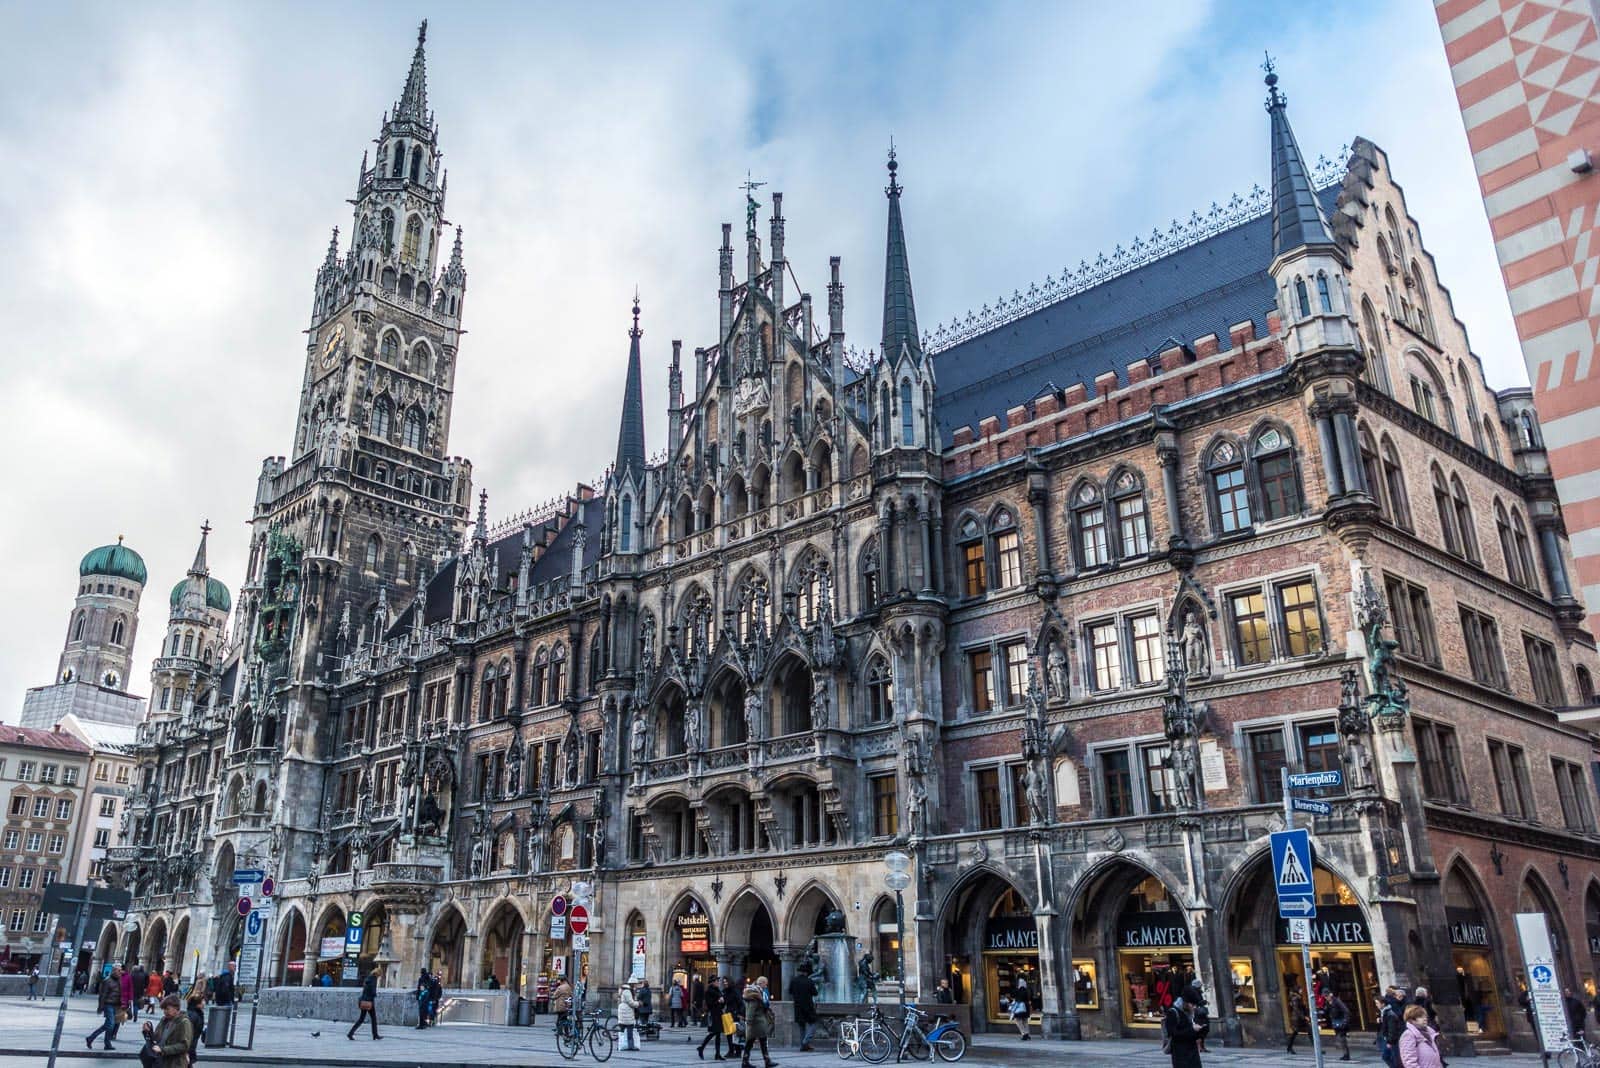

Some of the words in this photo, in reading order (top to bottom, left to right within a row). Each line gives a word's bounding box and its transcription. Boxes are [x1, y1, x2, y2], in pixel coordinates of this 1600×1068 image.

[1290, 773, 1337, 786] Marienplatz
[351, 912, 361, 927] S
[678, 914, 709, 926] Ratskelle
[350, 929, 360, 942] U
